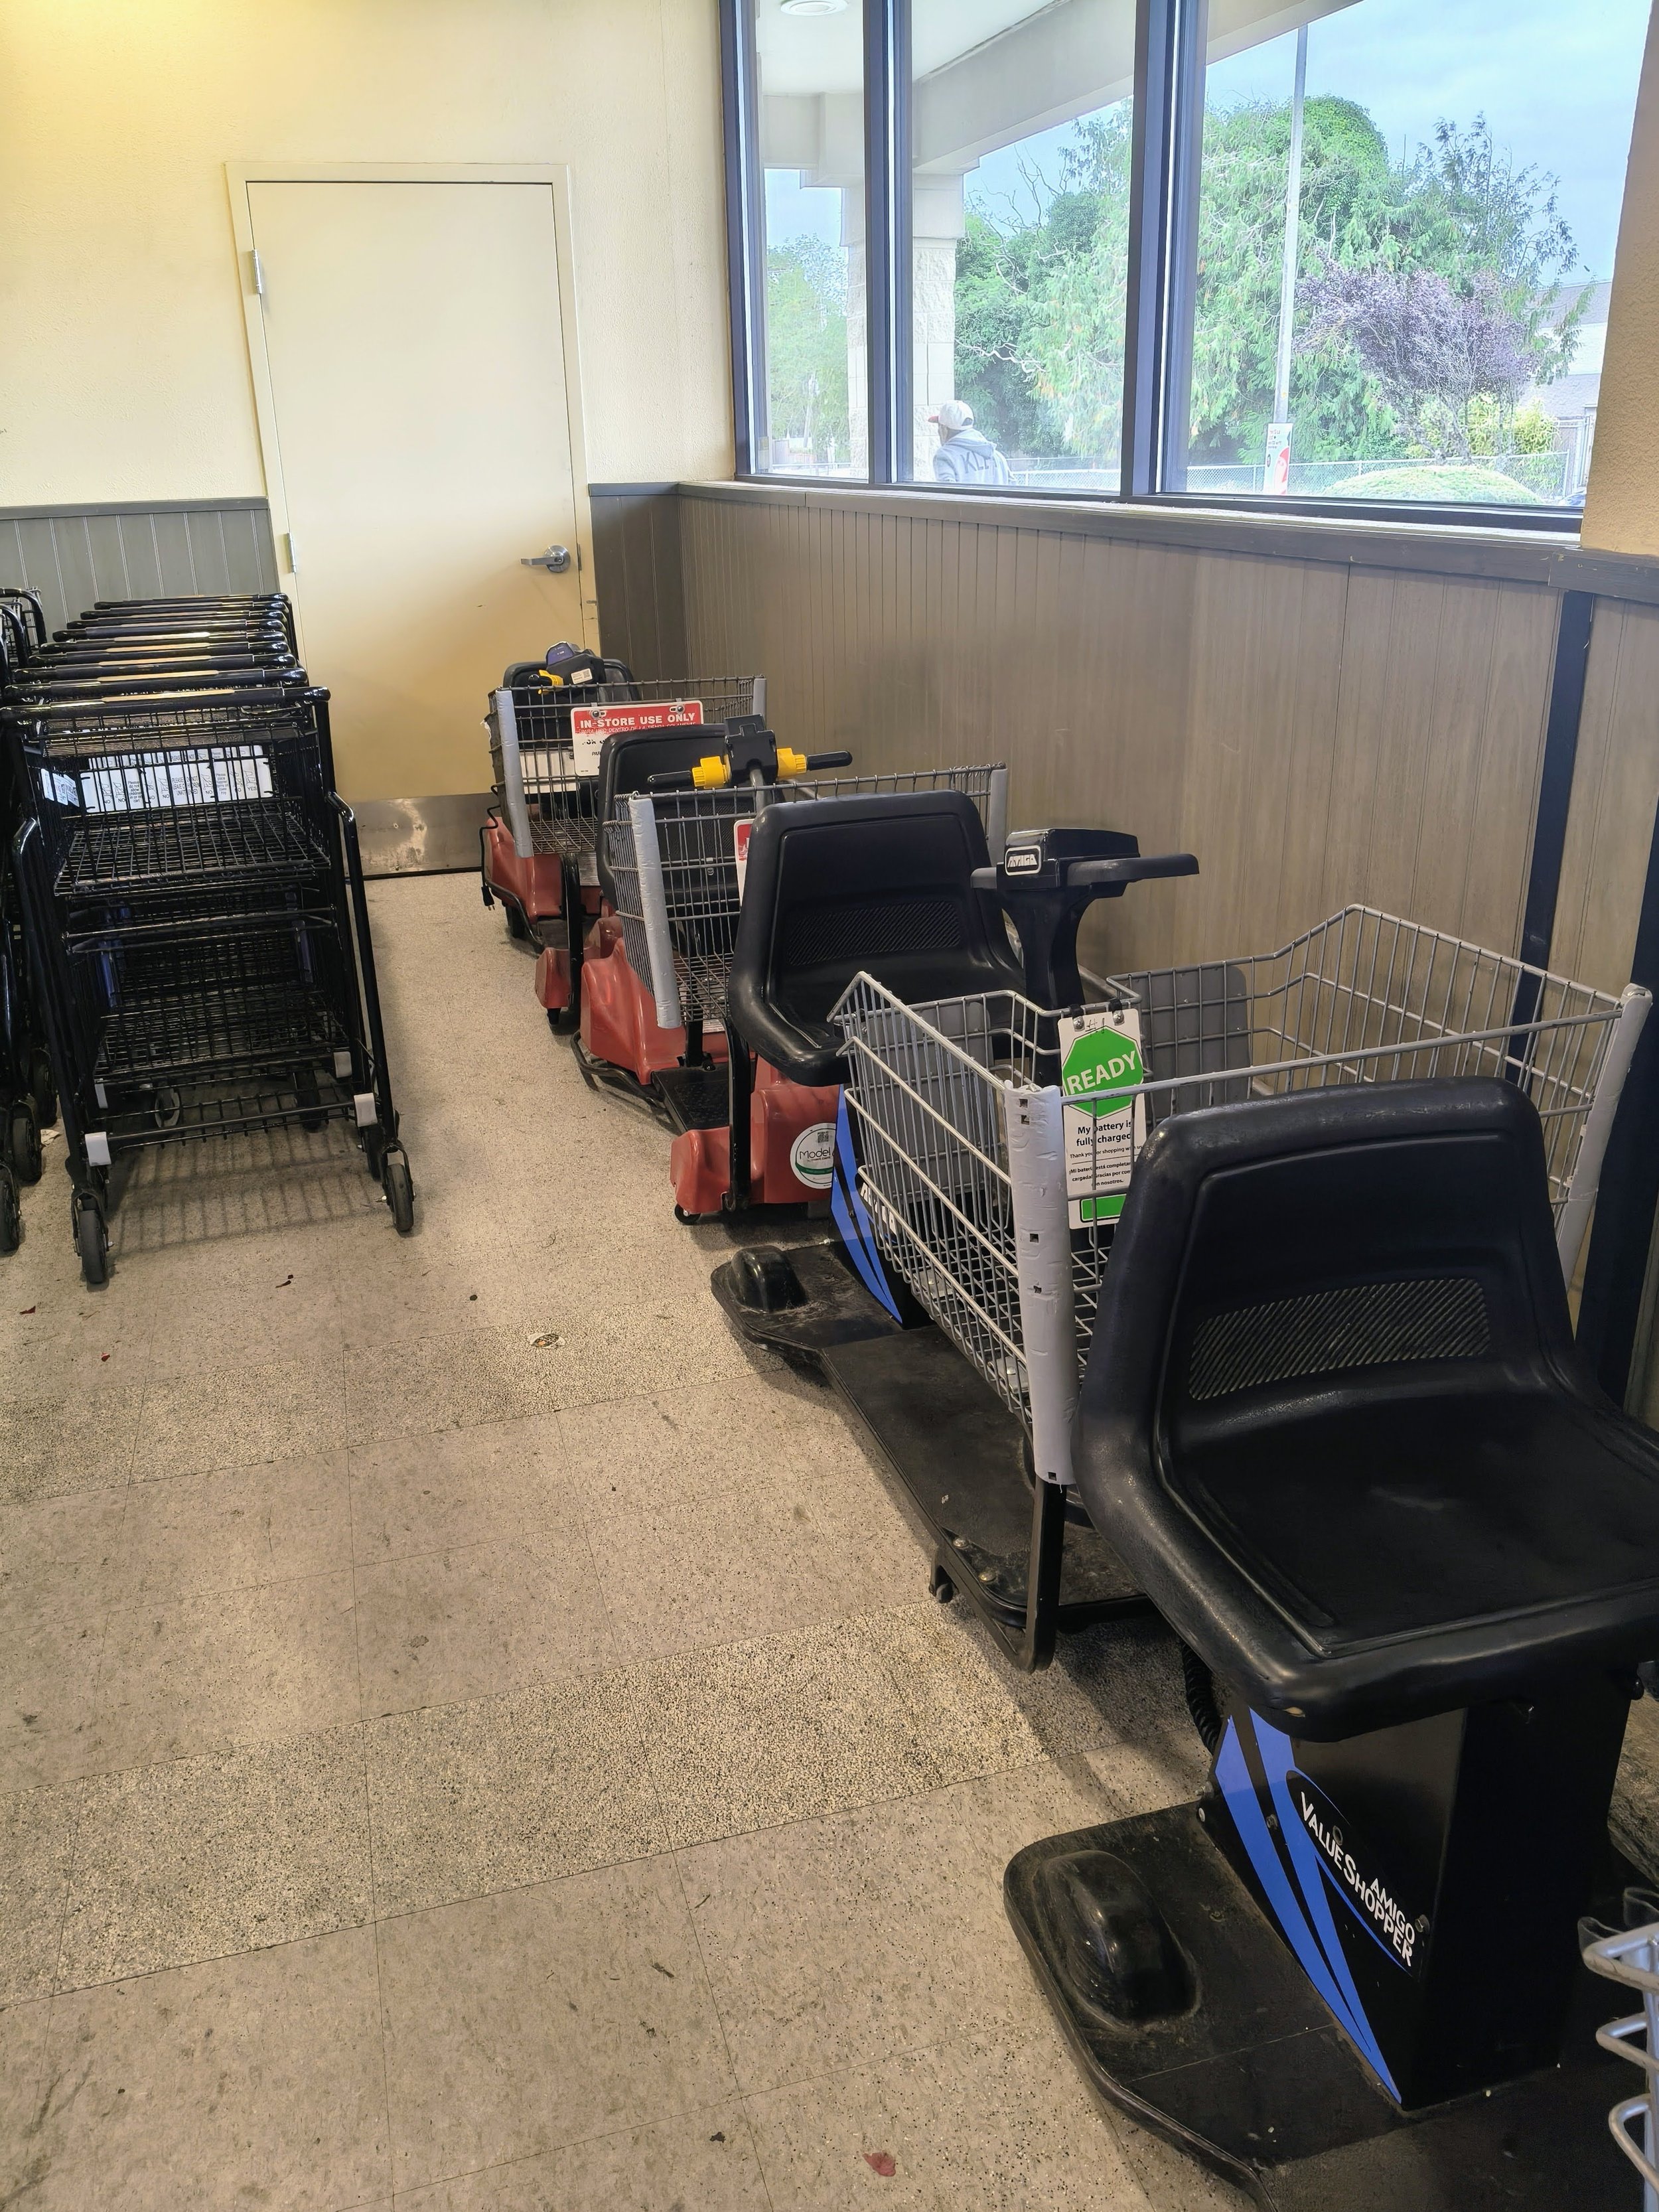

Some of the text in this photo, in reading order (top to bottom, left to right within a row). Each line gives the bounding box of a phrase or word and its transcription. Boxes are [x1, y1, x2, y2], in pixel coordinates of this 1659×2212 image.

[580, 717, 634, 729] IN-STORE
[640, 715, 663, 725] USE
[668, 712, 695, 723] ONLY
[1007, 853, 1038, 868] AMIGO
[1066, 1051, 1135, 1095] READY
[1078, 1126, 1091, 1135] My
[799, 1146, 831, 1159] Model
[1370, 1878, 1415, 1945] AMIGO
